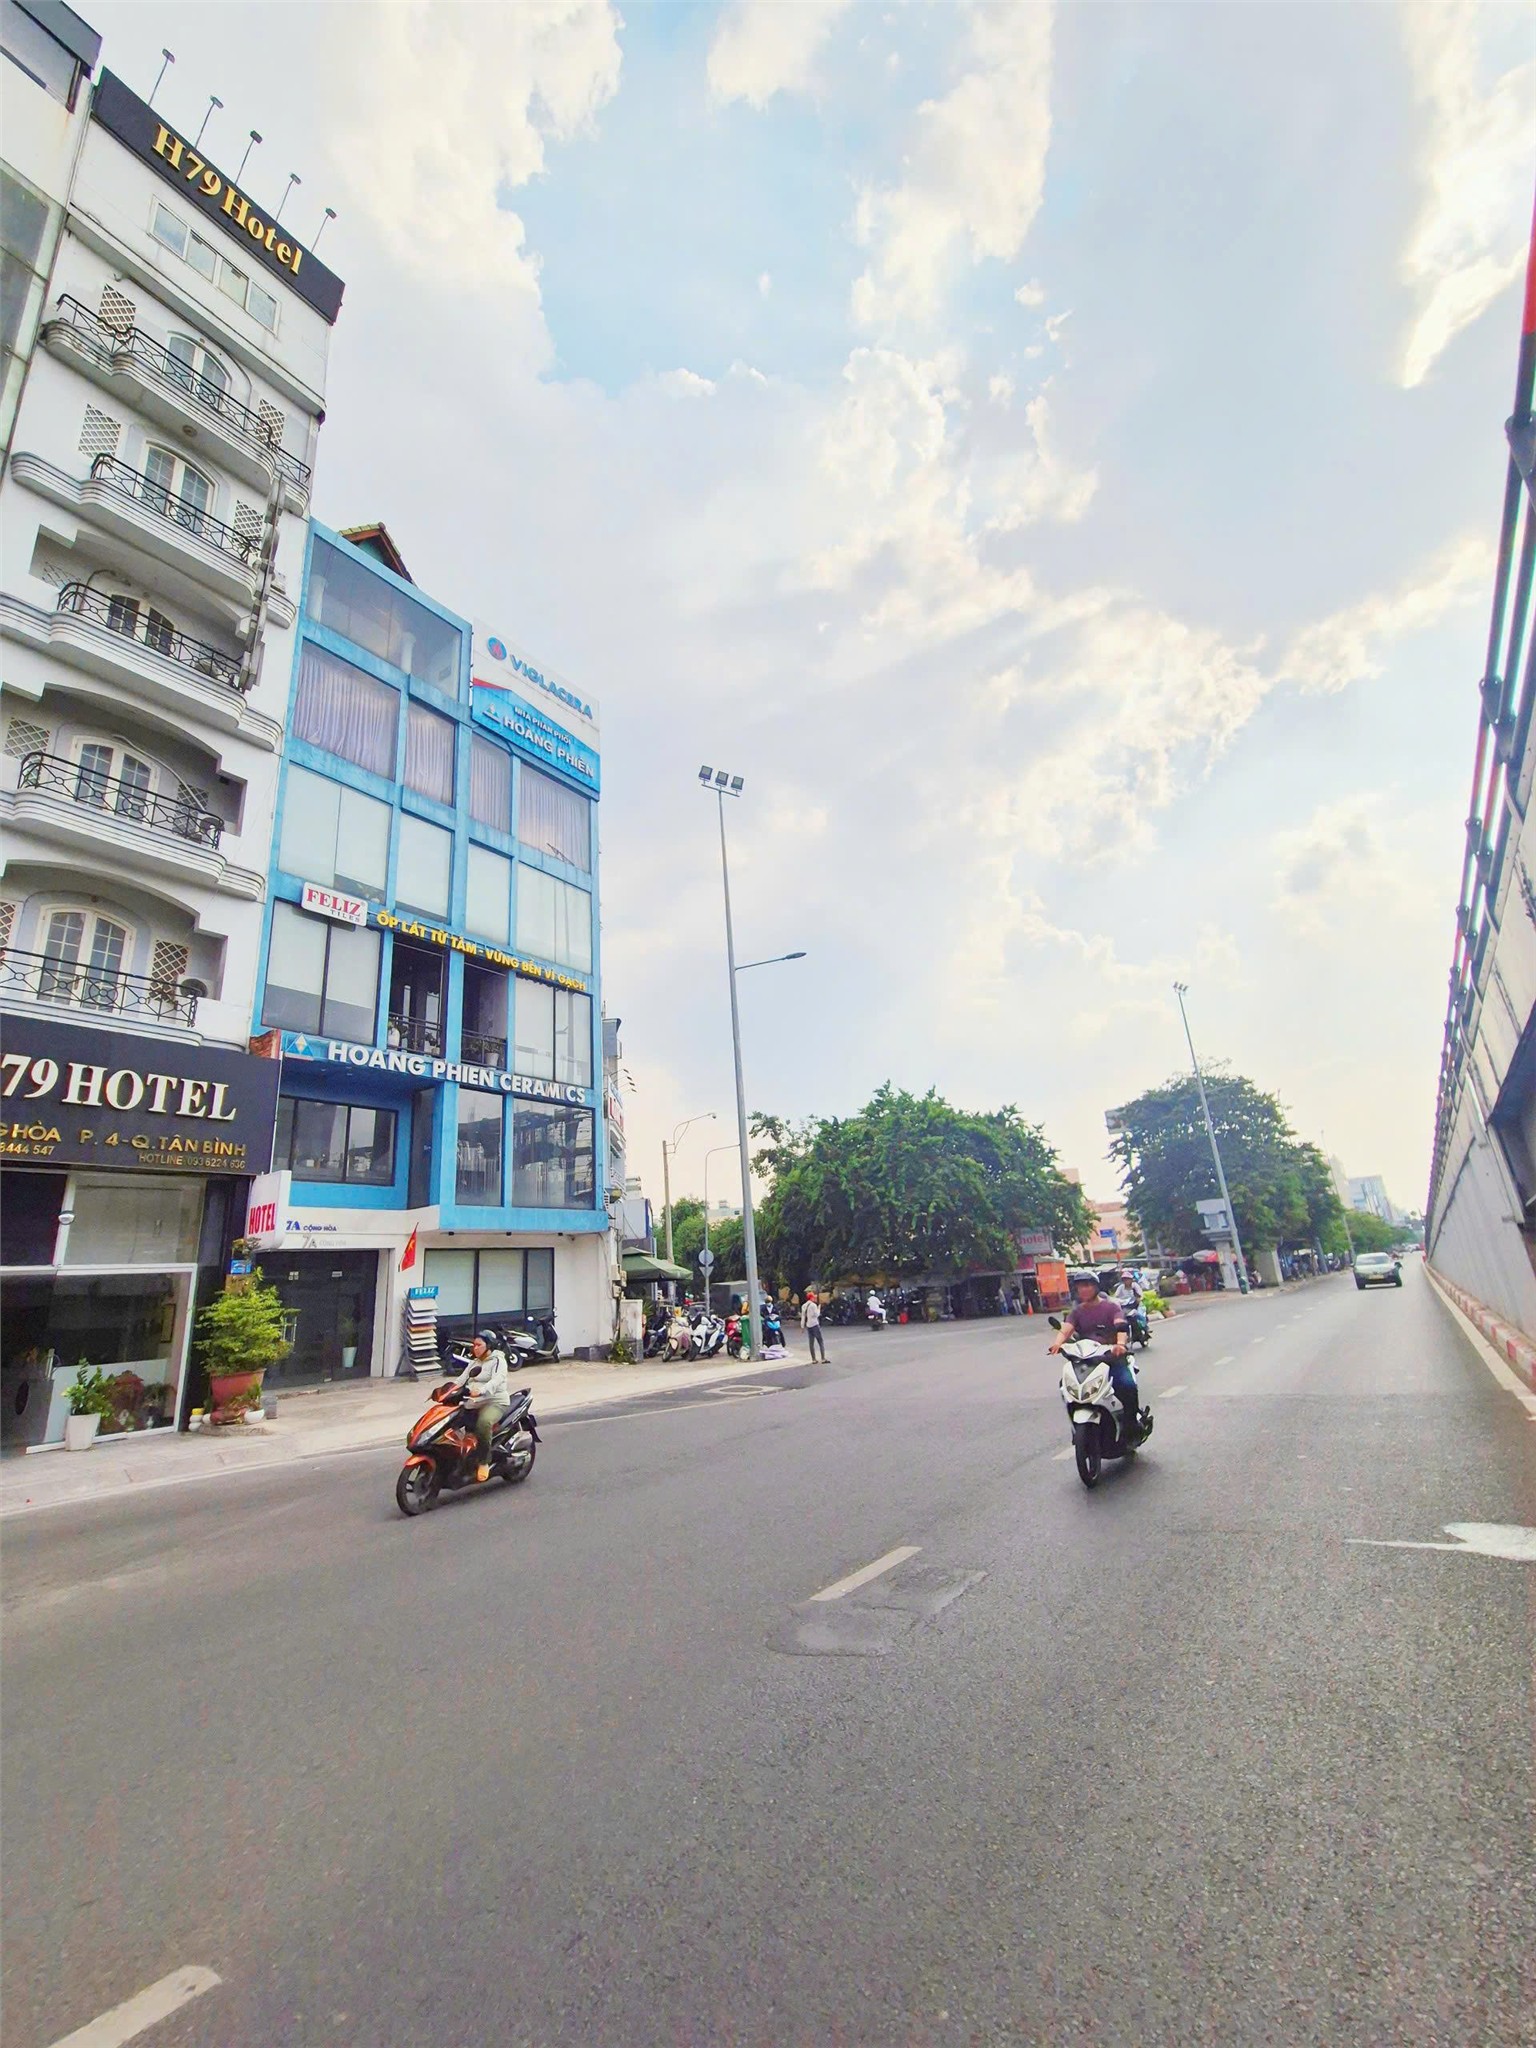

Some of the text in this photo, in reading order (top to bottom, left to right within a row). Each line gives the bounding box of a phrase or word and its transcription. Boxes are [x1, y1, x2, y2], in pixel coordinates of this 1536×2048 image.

[152, 122, 303, 275] H79 Hotel
[510, 654, 593, 720] VIGLACERA
[503, 715, 553, 754] HOÀNG
[306, 888, 361, 917] FELIZ
[330, 909, 360, 923] TILES
[401, 920, 426, 938] LÁT
[328, 1040, 586, 1104] HOANG PHIEN CERAMICS
[61, 1062, 237, 1121] HOTEL
[12, 1120, 61, 1142] HÒA
[202, 1136, 247, 1157] BÌNH
[33, 1144, 55, 1156] 547
[248, 1203, 275, 1235] HOTEL
[286, 1220, 301, 1231] 7A
